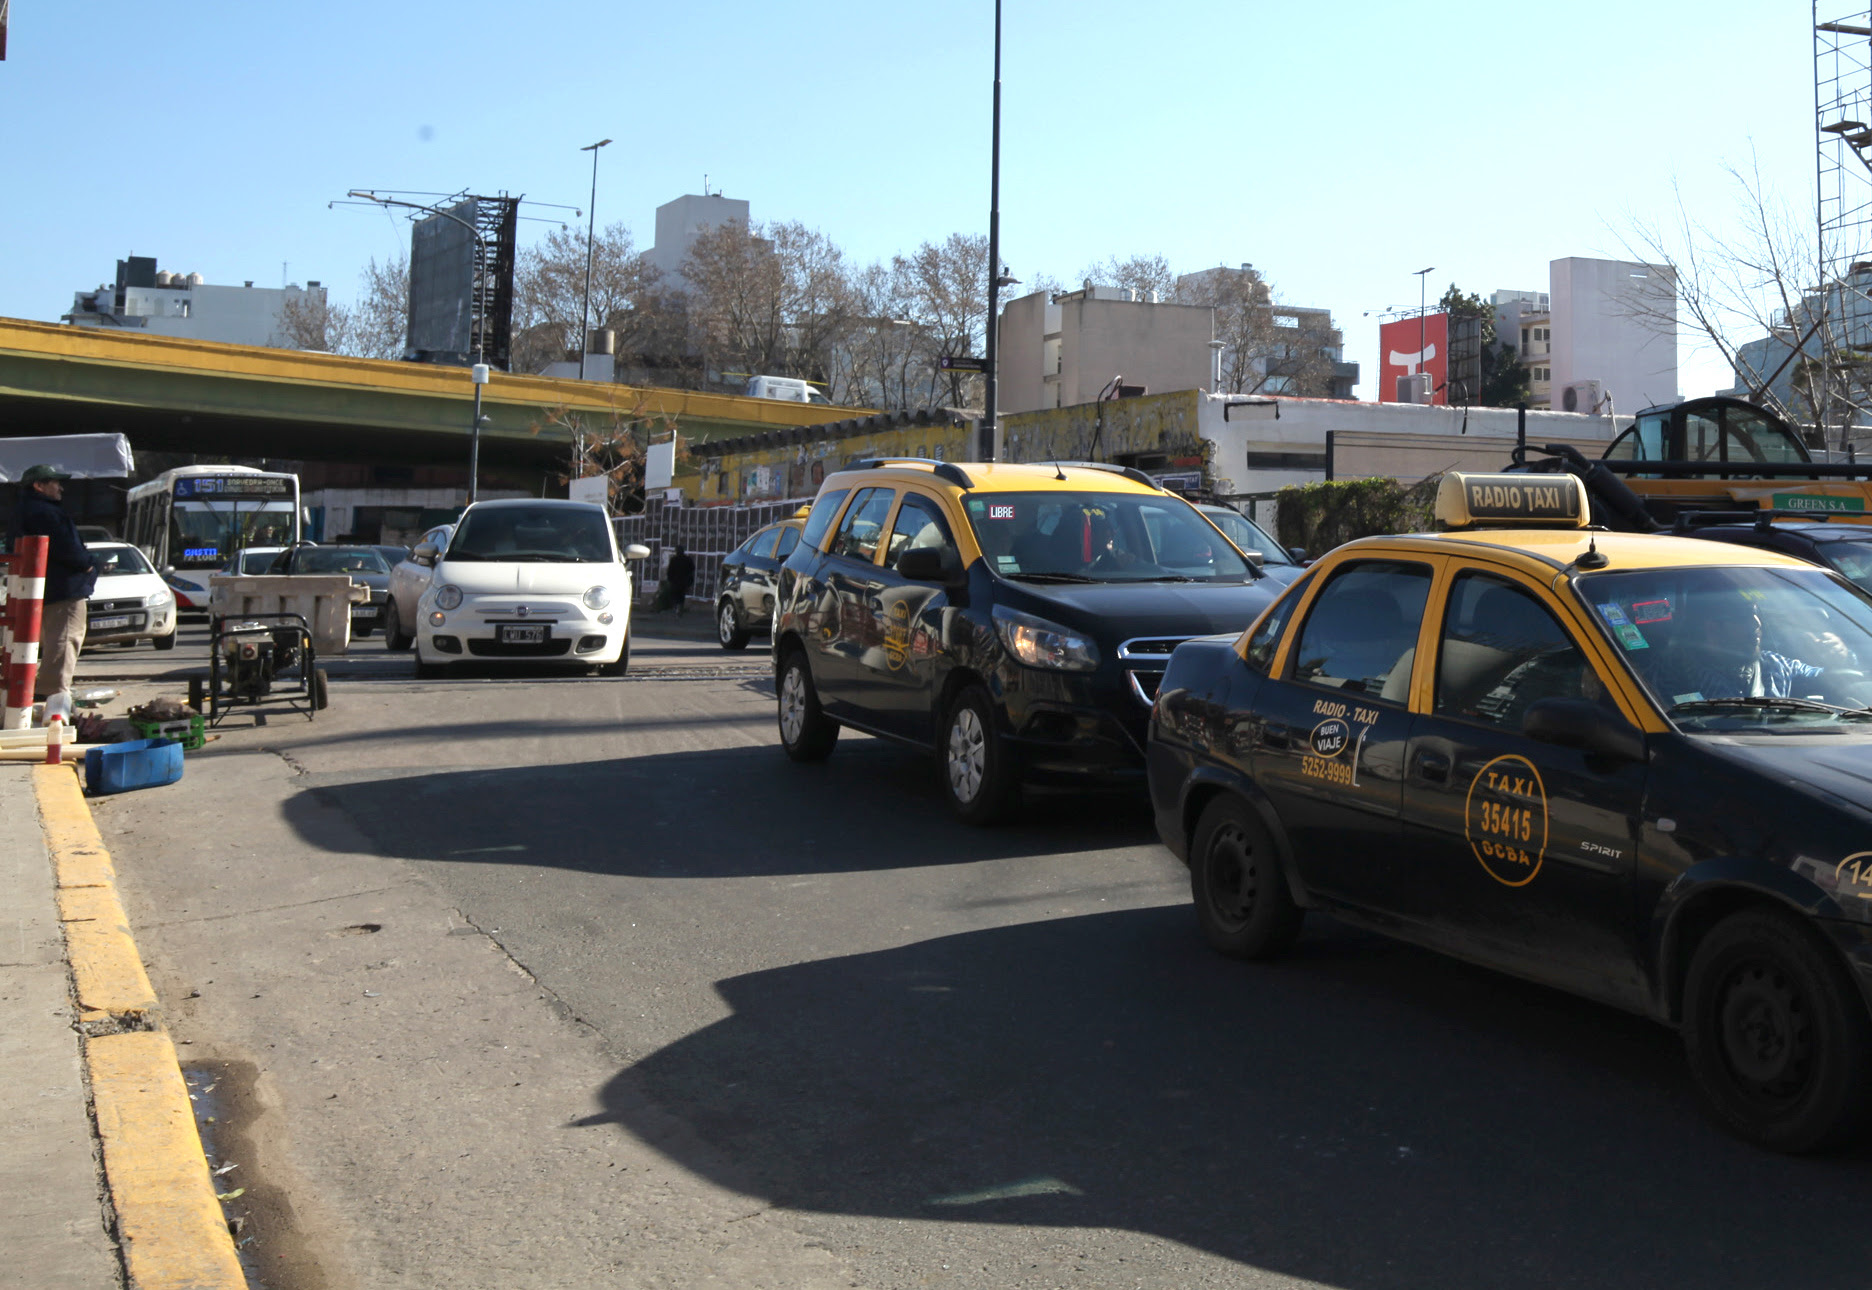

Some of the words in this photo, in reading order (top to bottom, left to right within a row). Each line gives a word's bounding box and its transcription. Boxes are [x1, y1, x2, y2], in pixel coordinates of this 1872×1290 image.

[194, 479, 224, 493] 151
[1471, 485, 1521, 509] RADIO
[1524, 486, 1560, 512] TAXI
[1788, 498, 1827, 510] GREEN
[990, 506, 1013, 518] LIBRE
[1313, 700, 1346, 718] RADIO
[1353, 707, 1379, 725] TAXI
[1320, 724, 1340, 736] BUEN
[1317, 736, 1342, 751] VIAJE
[1302, 755, 1352, 785] 5252-9999
[1488, 772, 1533, 797] TAXI
[1481, 800, 1532, 841] 35415
[1481, 840, 1531, 866] GCBA
[1580, 841, 1623, 859] SPIRIT
